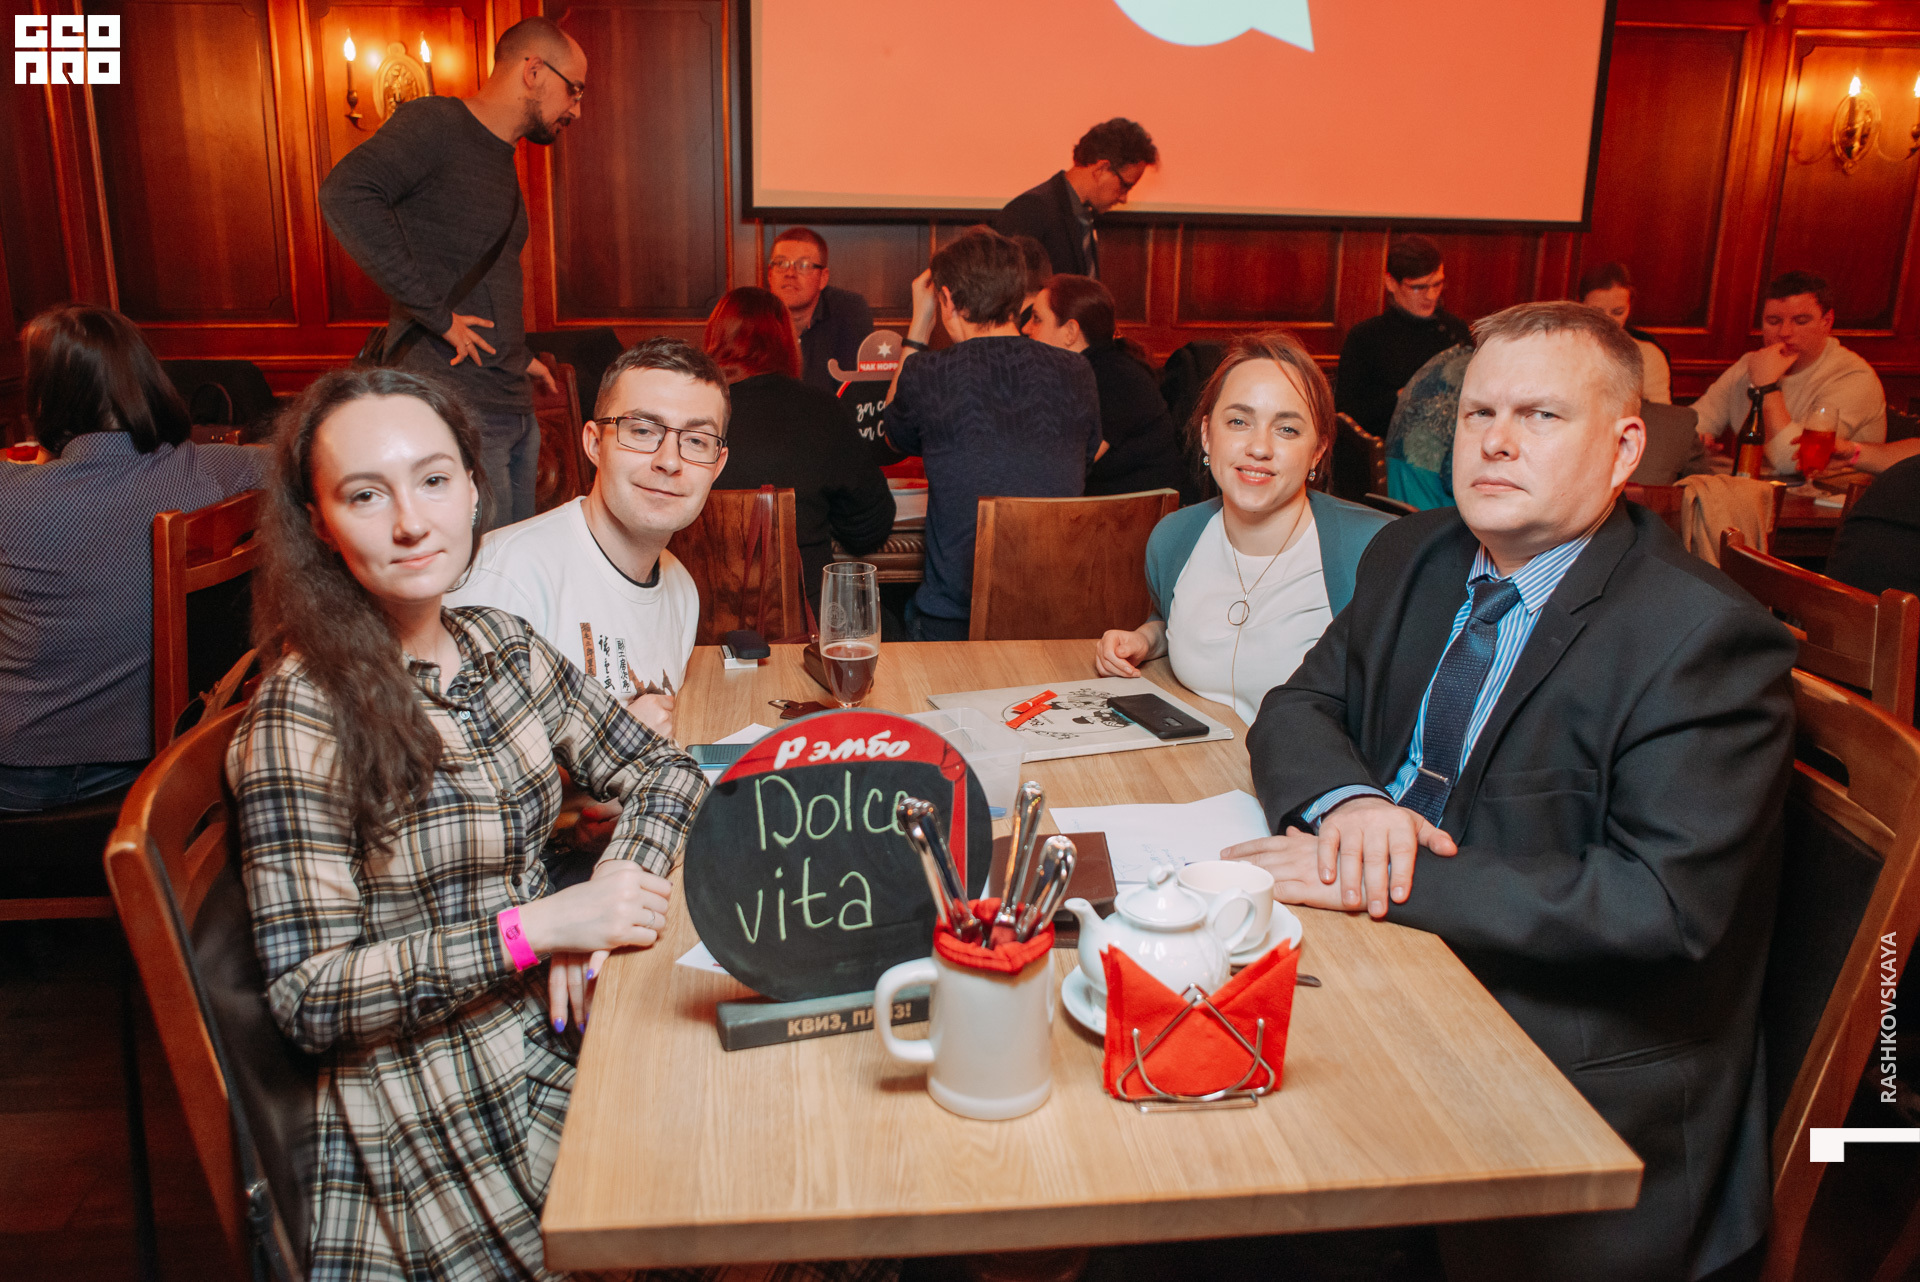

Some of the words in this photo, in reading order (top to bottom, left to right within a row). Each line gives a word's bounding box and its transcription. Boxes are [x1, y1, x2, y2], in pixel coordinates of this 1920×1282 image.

[860, 363, 876, 371] ЧАК
[877, 362, 898, 371] НОРР
[755, 770, 909, 850] Dolce
[735, 856, 874, 943] vita
[787, 1013, 847, 1037] КВИЗ,
[852, 1002, 912, 1026] ПЛЗ!
